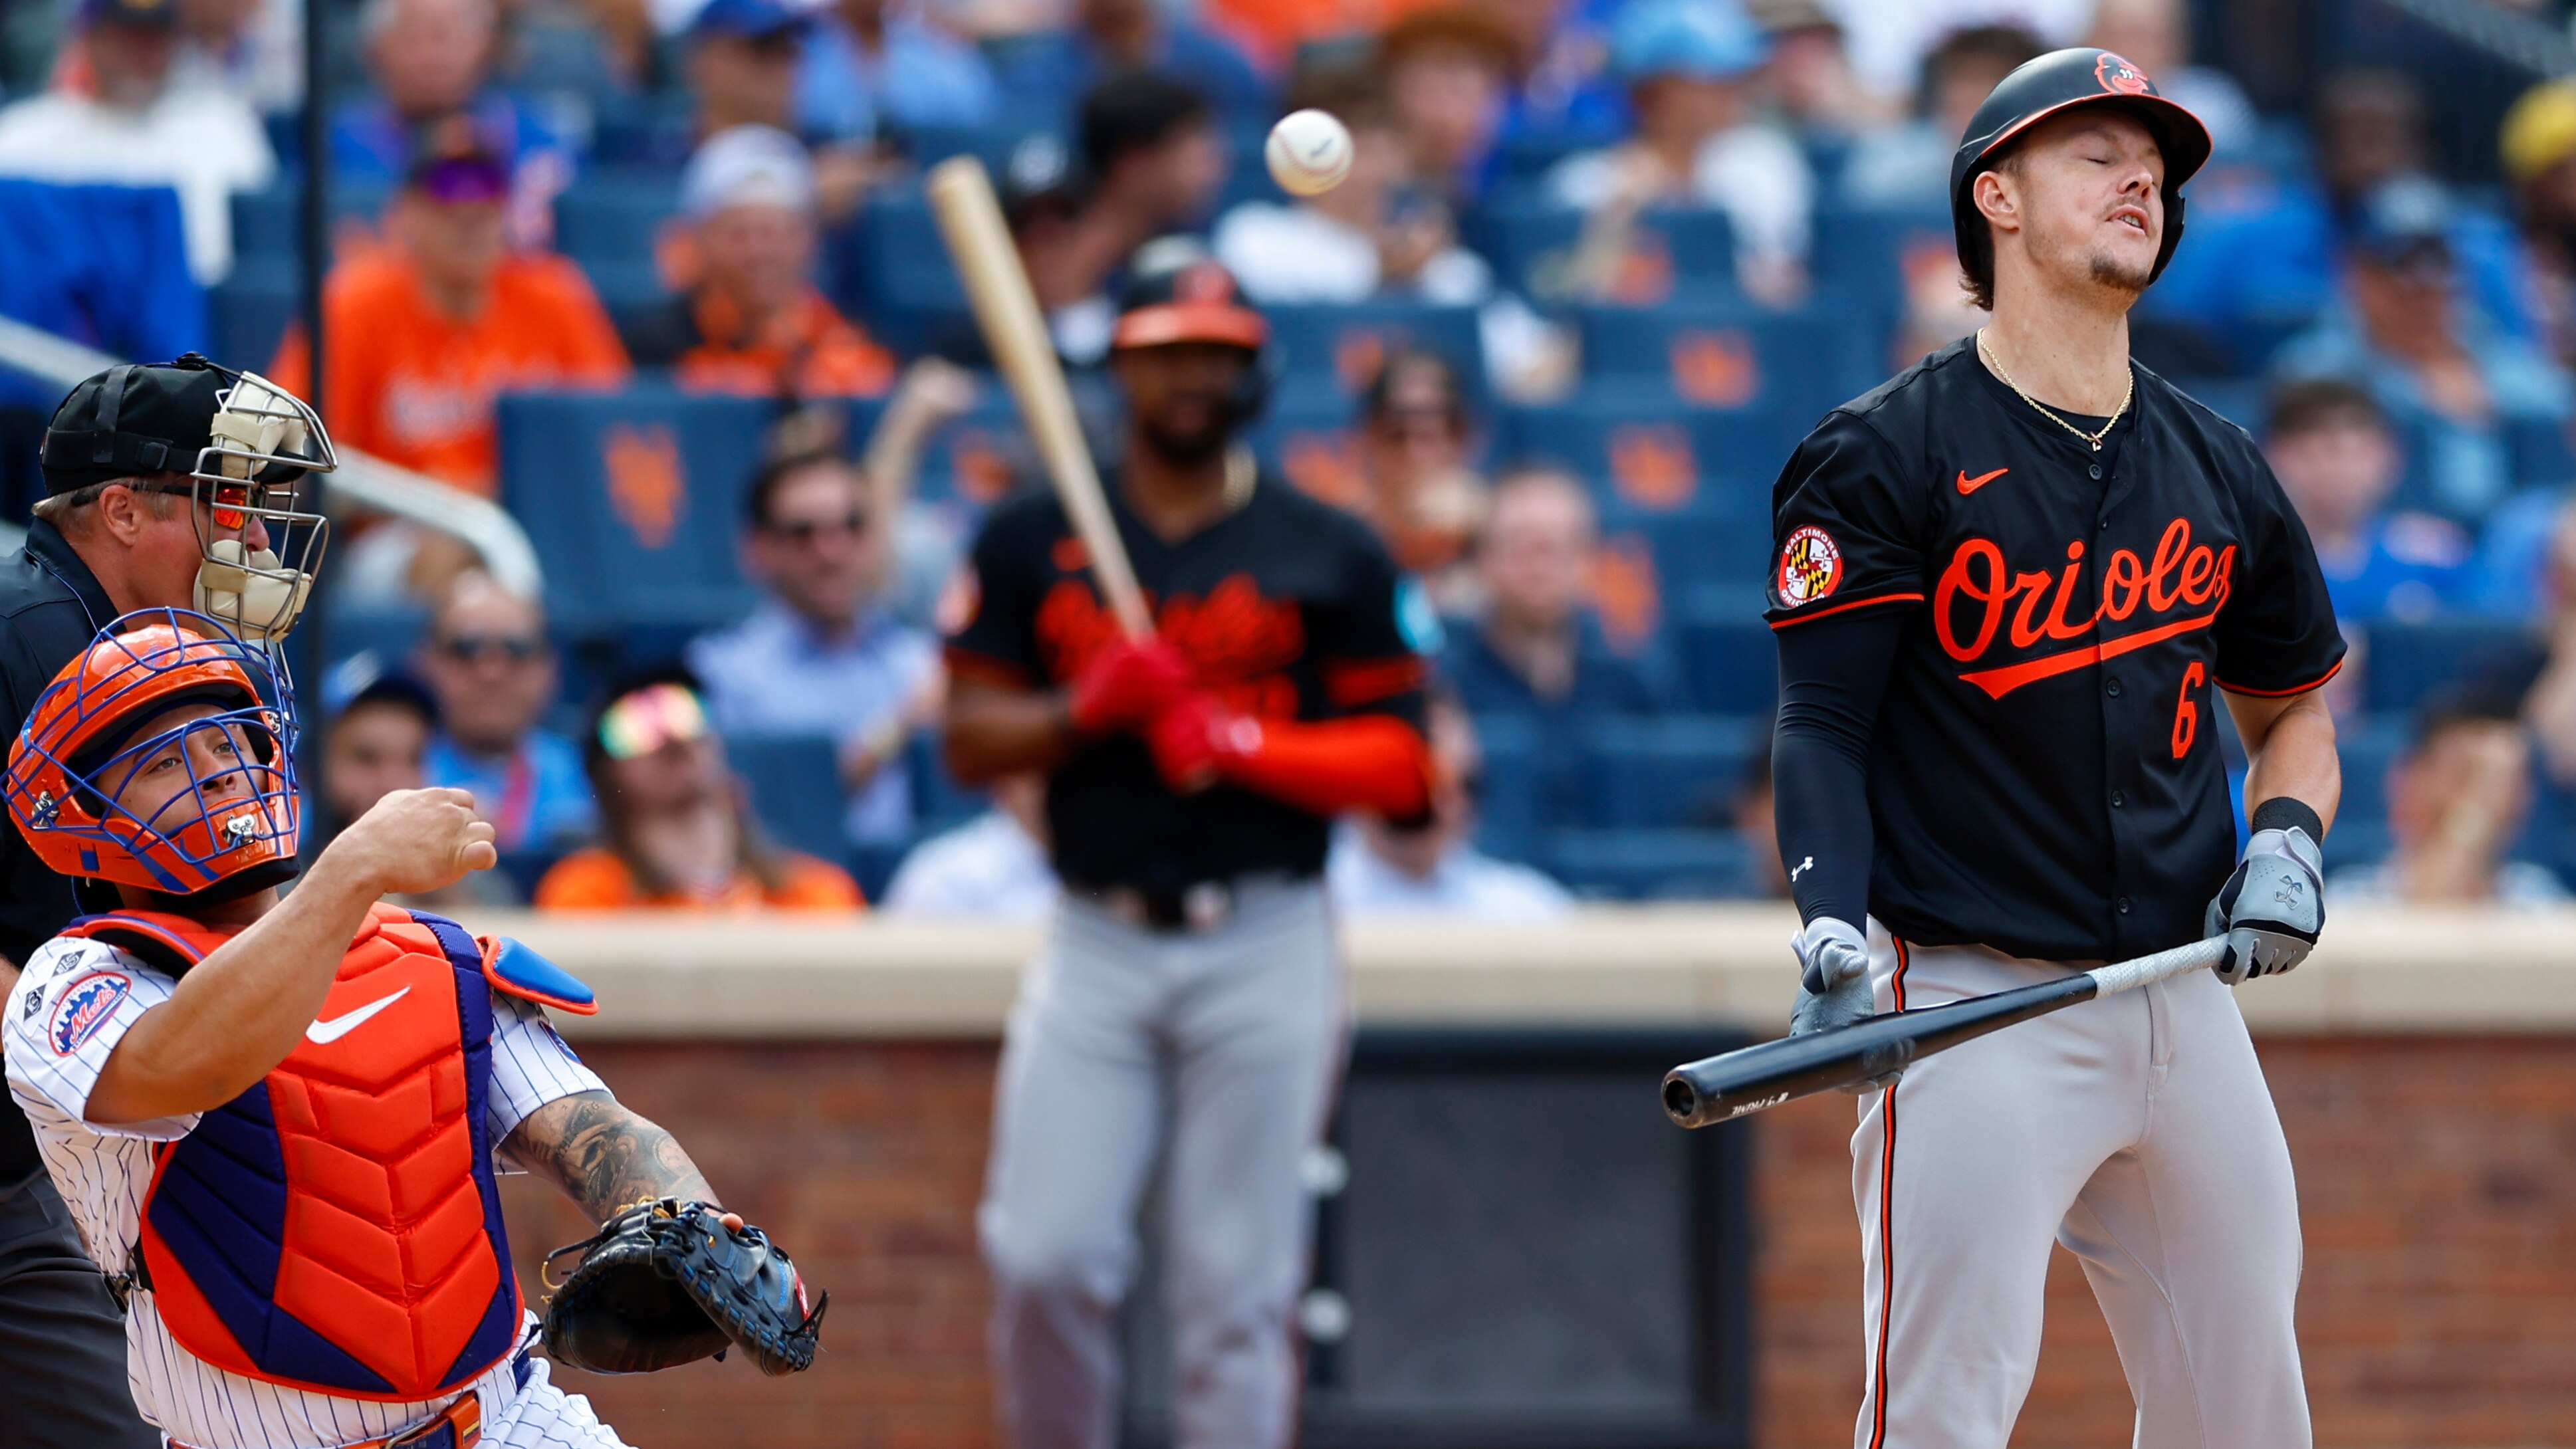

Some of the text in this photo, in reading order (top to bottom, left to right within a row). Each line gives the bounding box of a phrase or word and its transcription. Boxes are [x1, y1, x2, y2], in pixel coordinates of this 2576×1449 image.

[1784, 528, 1839, 560] BALTIMORE
[1782, 589, 1825, 607] ORIOS
[1934, 517, 2236, 662] Orioles
[2172, 661, 2204, 759] 6
[70, 986, 116, 1043] Mets
